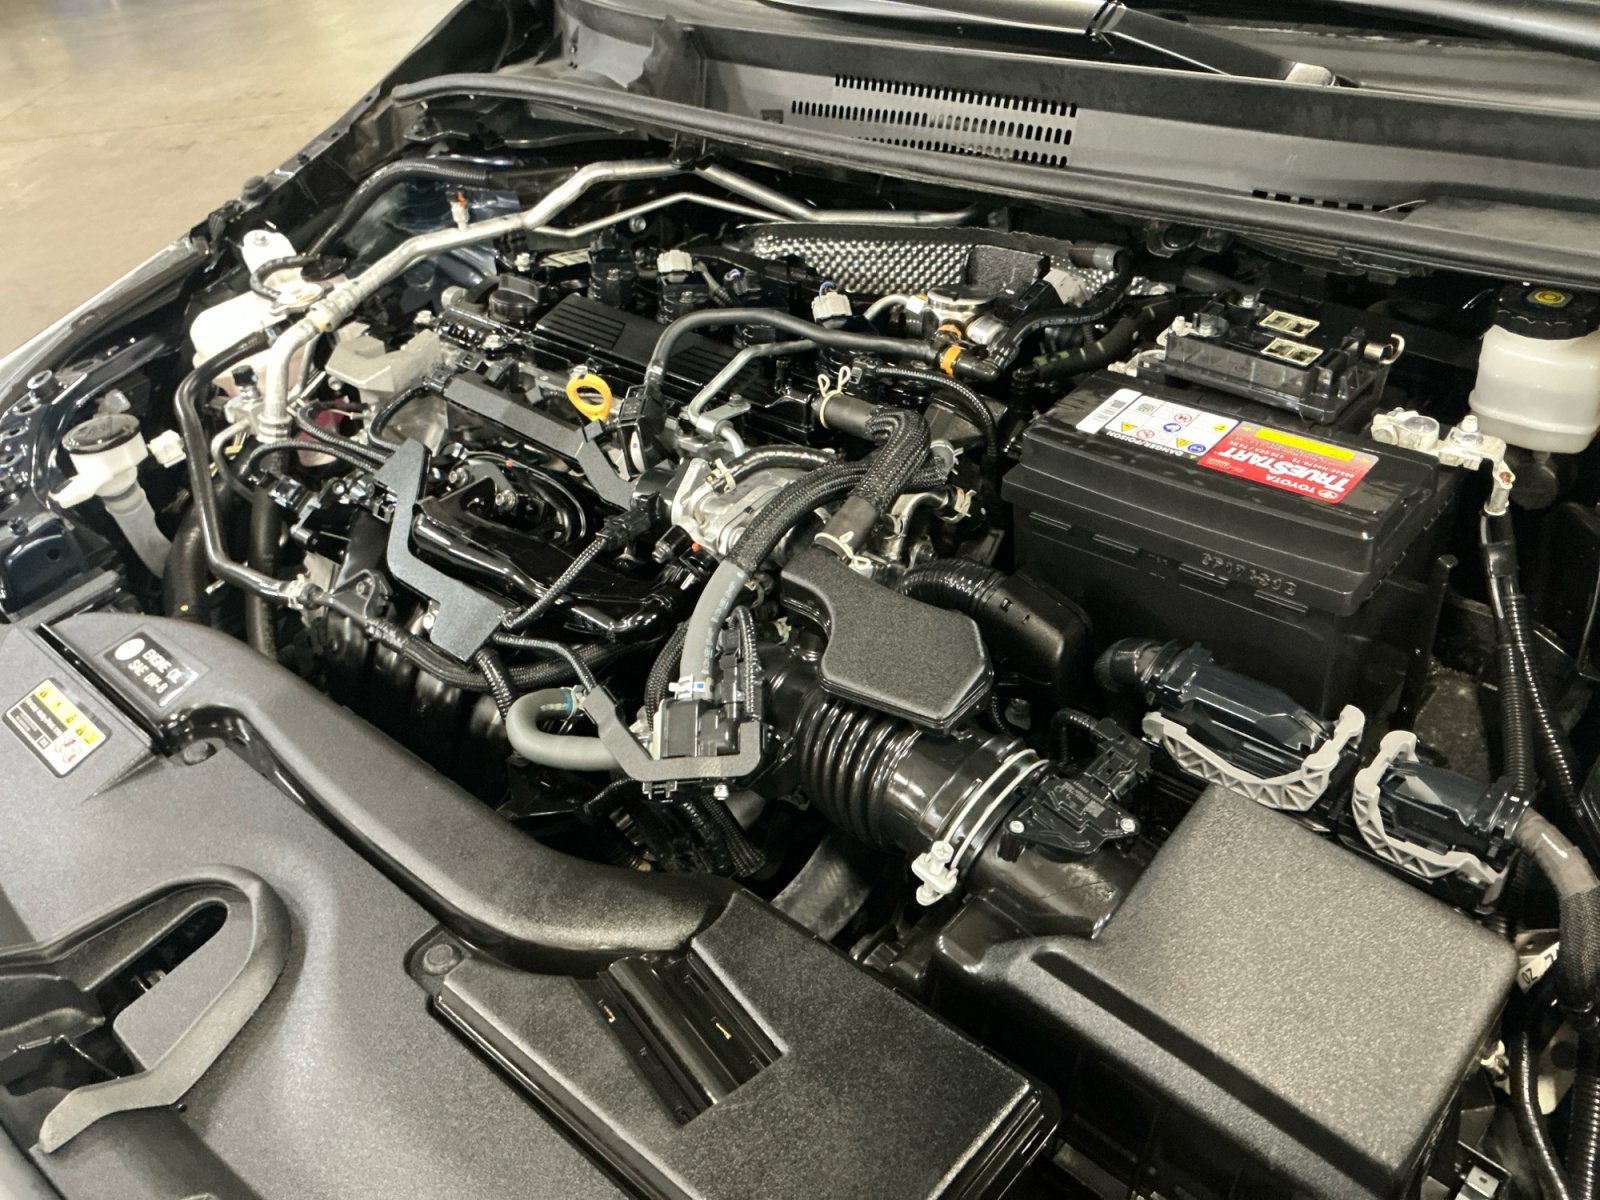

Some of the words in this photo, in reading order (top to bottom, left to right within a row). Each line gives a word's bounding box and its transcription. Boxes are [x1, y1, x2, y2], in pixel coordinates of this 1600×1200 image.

[1106, 430, 1184, 457] DANGER/POISON
[1217, 447, 1350, 493] TRUESTART
[1265, 474, 1316, 494] TOYOTA
[128, 659, 149, 677] SAE
[142, 648, 172, 674] ENGINE
